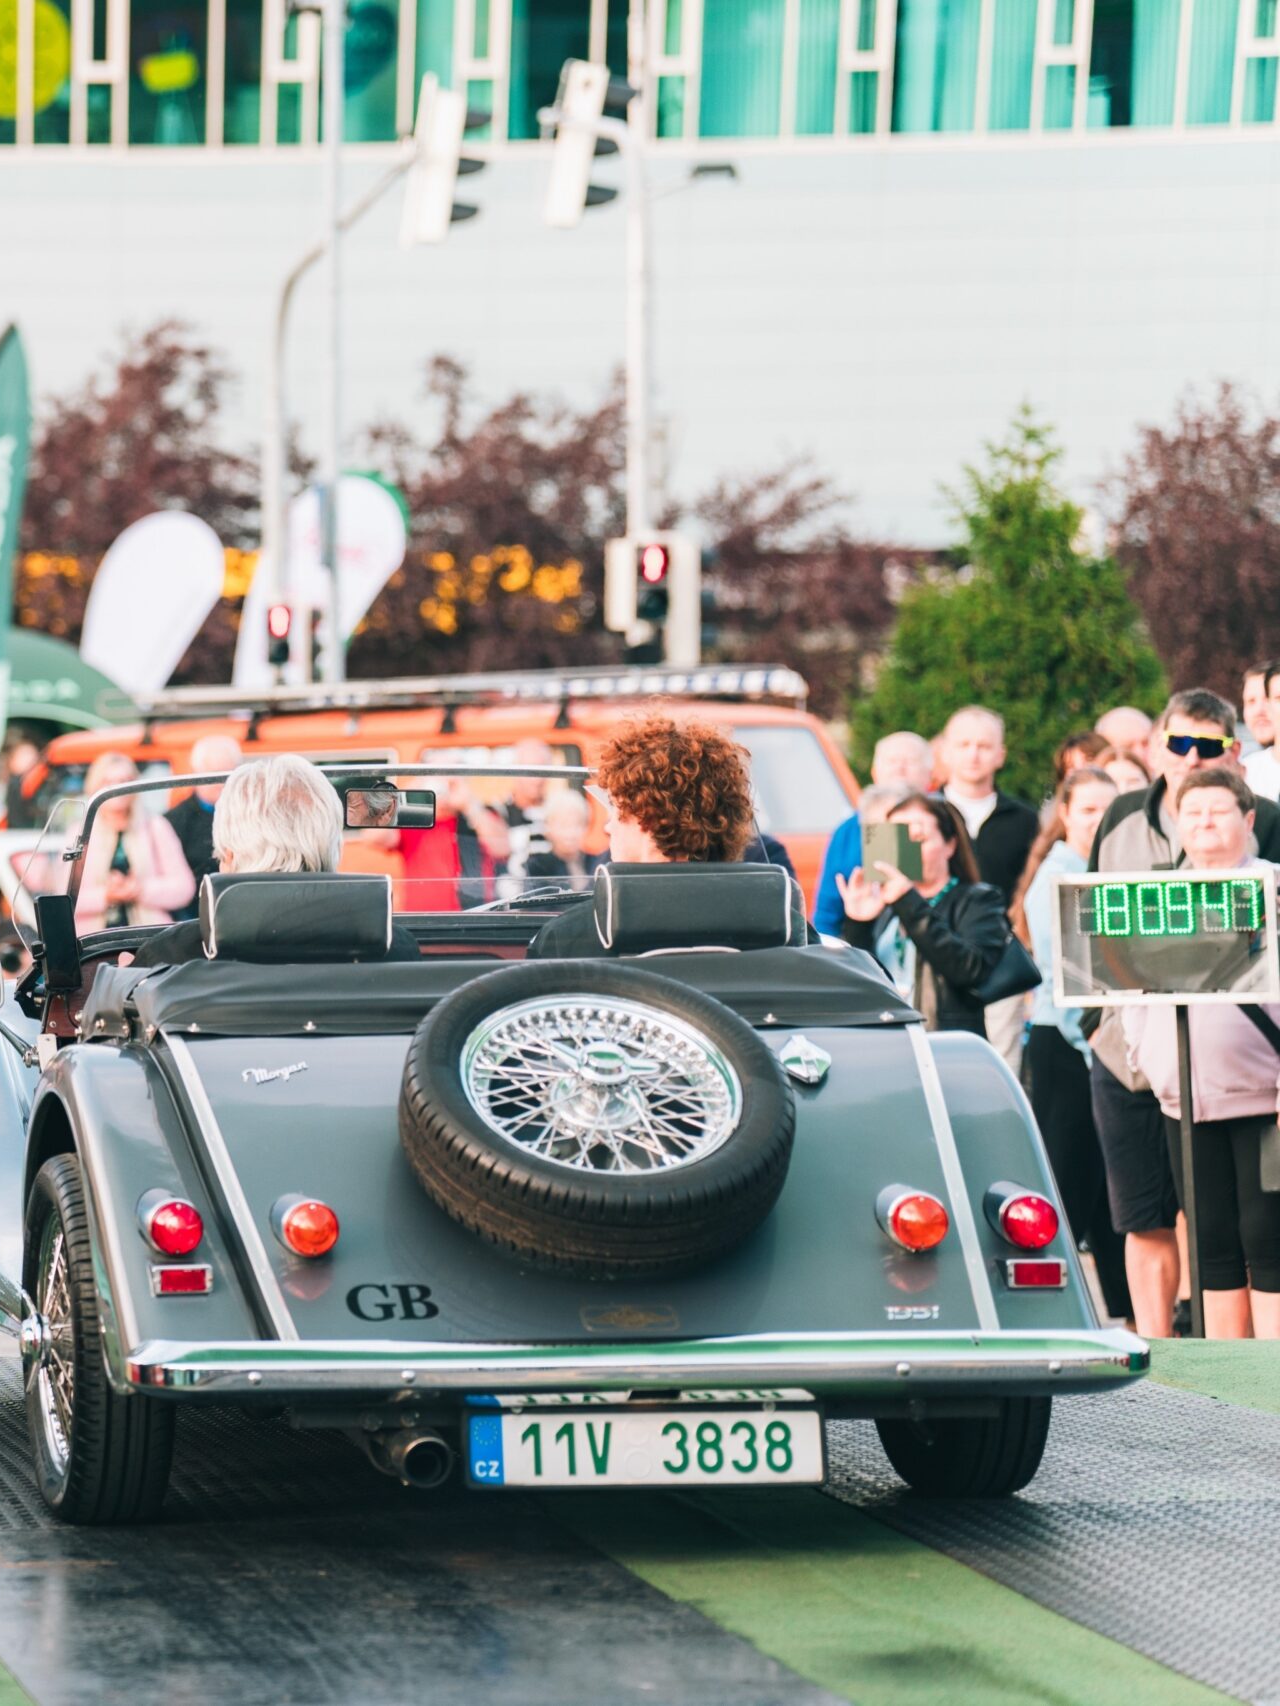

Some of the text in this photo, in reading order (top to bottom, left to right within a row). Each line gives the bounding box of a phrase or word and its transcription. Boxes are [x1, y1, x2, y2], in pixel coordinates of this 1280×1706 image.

[241, 1060, 308, 1084] Morgan
[345, 1283, 440, 1322] GB
[520, 1420, 793, 1477] 11V 3838
[474, 1460, 500, 1478] CZ
